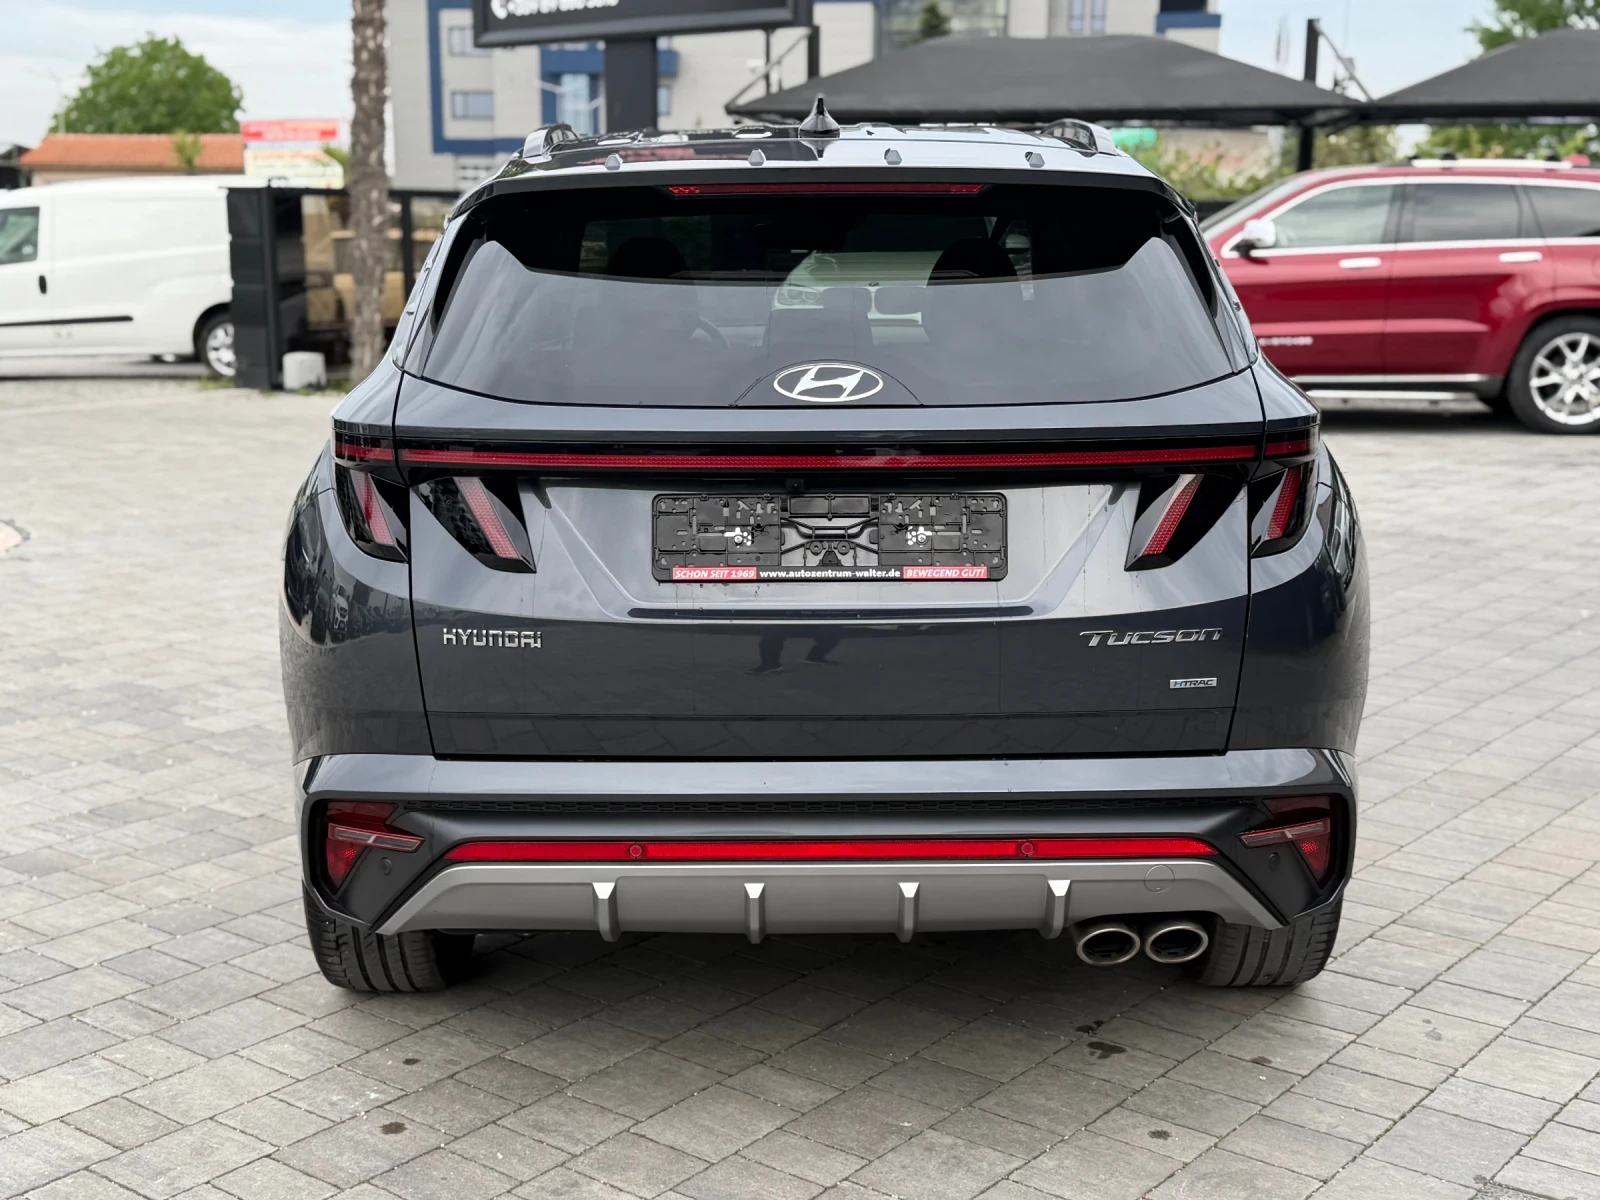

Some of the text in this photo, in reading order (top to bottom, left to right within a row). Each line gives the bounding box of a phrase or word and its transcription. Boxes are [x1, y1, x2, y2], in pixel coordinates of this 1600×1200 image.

[710, 569, 729, 578] SEIT
[730, 569, 755, 578] 1969
[759, 568, 901, 578] www.autozentrum-walter.de
[906, 568, 985, 577] BEWEGEND GUT!
[443, 628, 542, 648] HYUNDAI
[1079, 627, 1223, 647] TUCSON
[1173, 679, 1214, 687] HTRAC
